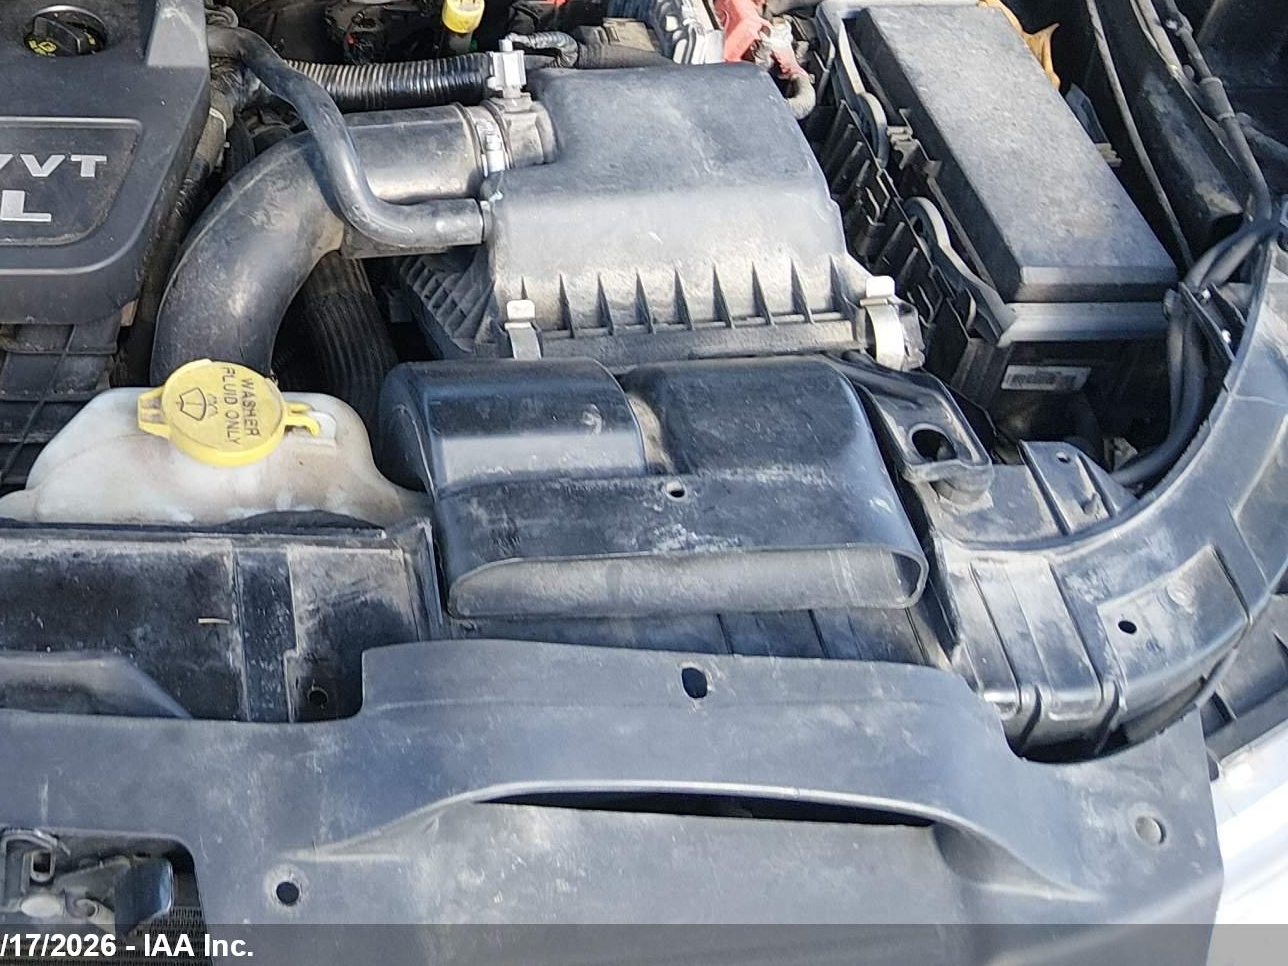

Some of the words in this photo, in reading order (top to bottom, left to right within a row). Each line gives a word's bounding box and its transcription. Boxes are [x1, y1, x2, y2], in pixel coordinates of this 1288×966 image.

[221, 366, 239, 405] FLUID
[241, 377, 261, 437] WASHER
[224, 409, 241, 445] ONLY
